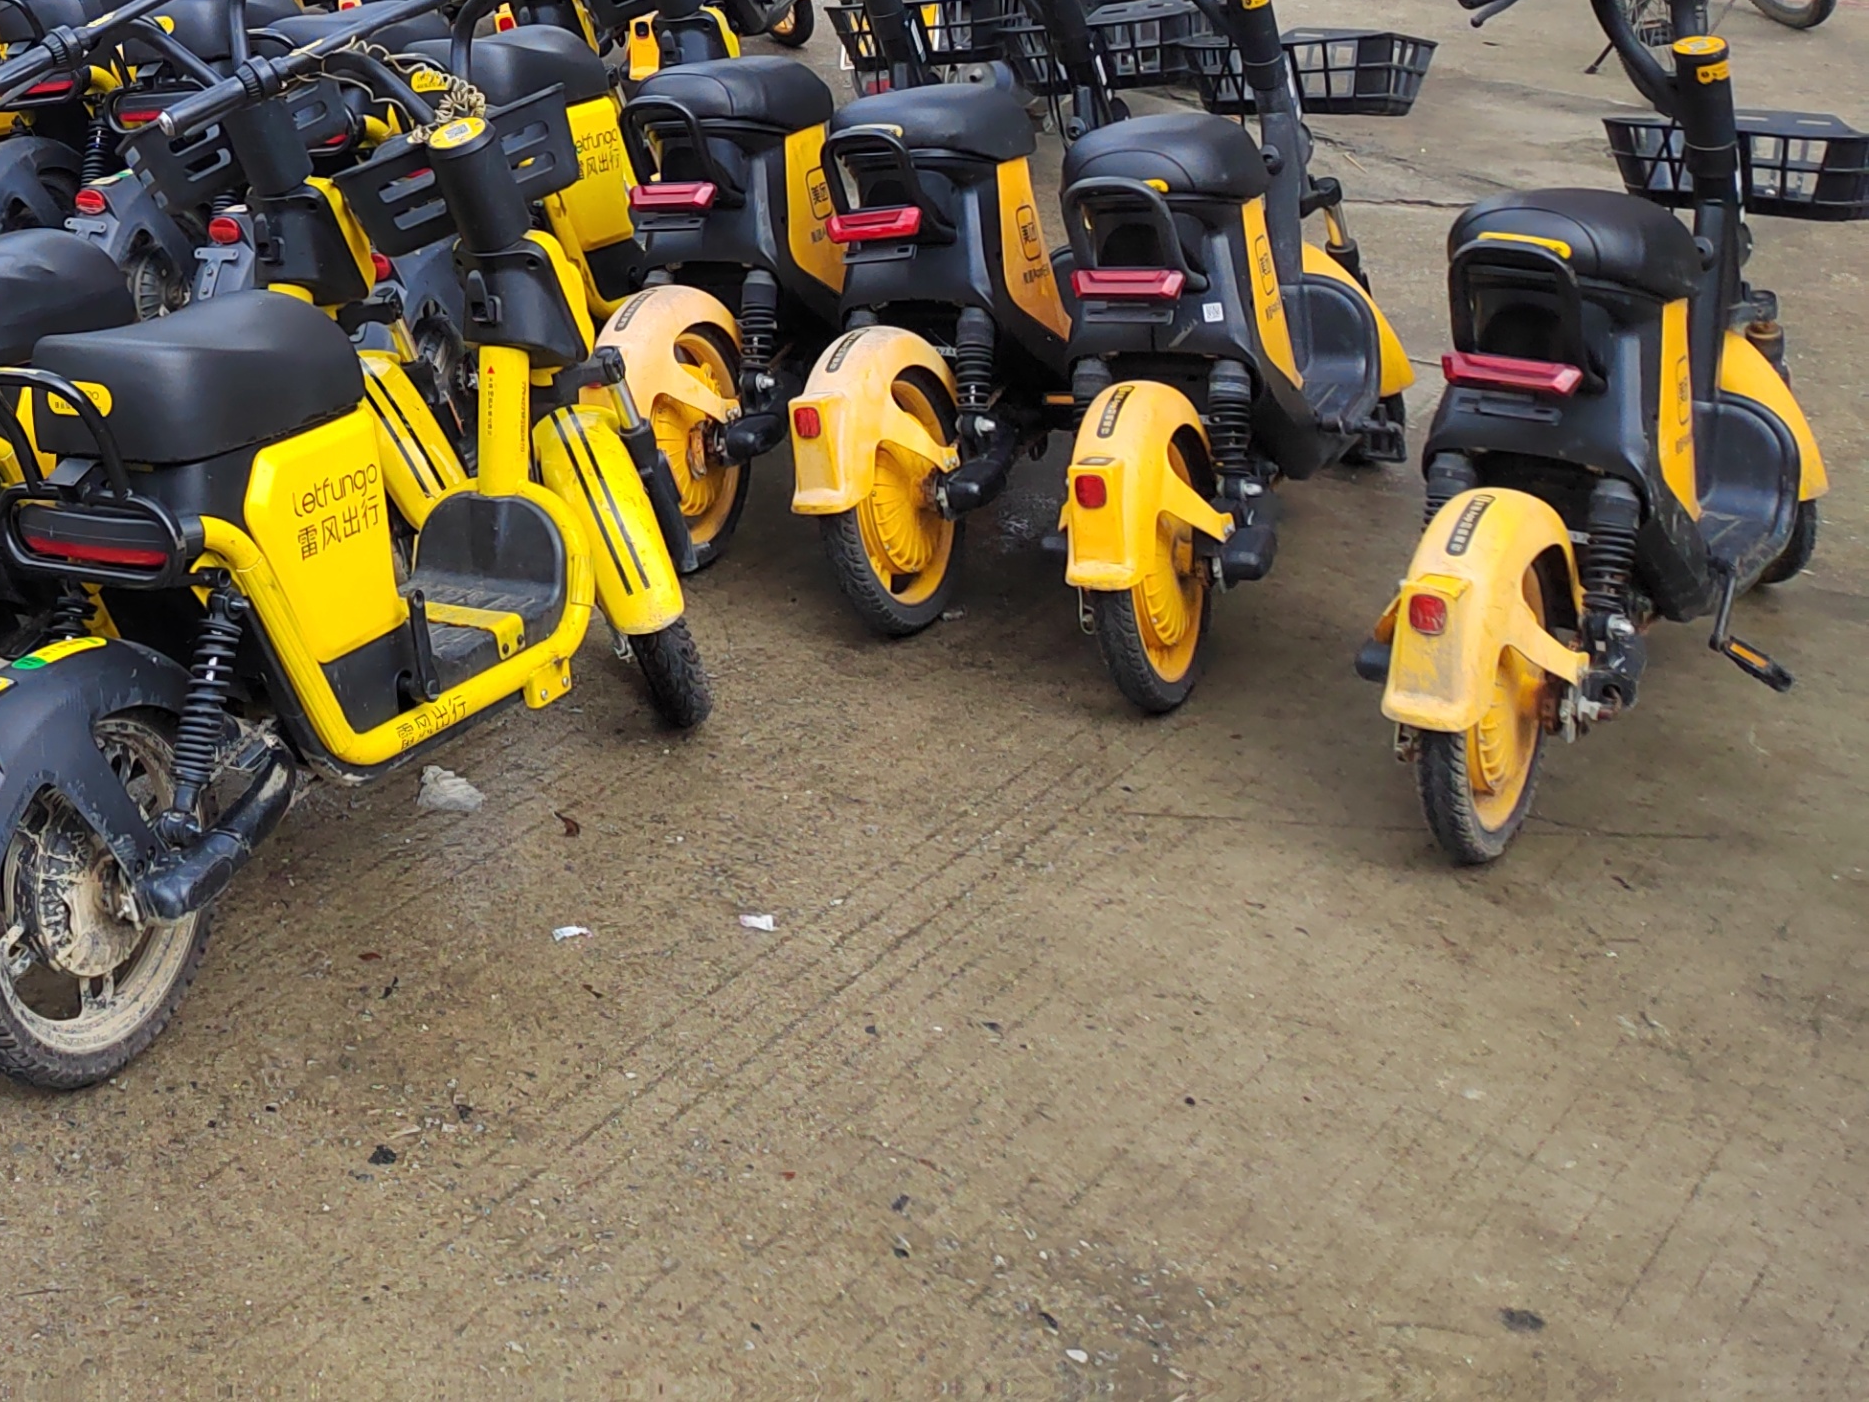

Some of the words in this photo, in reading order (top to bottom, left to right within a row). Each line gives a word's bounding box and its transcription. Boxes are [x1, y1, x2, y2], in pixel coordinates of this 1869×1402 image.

[575, 128, 618, 154] etfungo
[297, 494, 379, 561] 雷风出行
